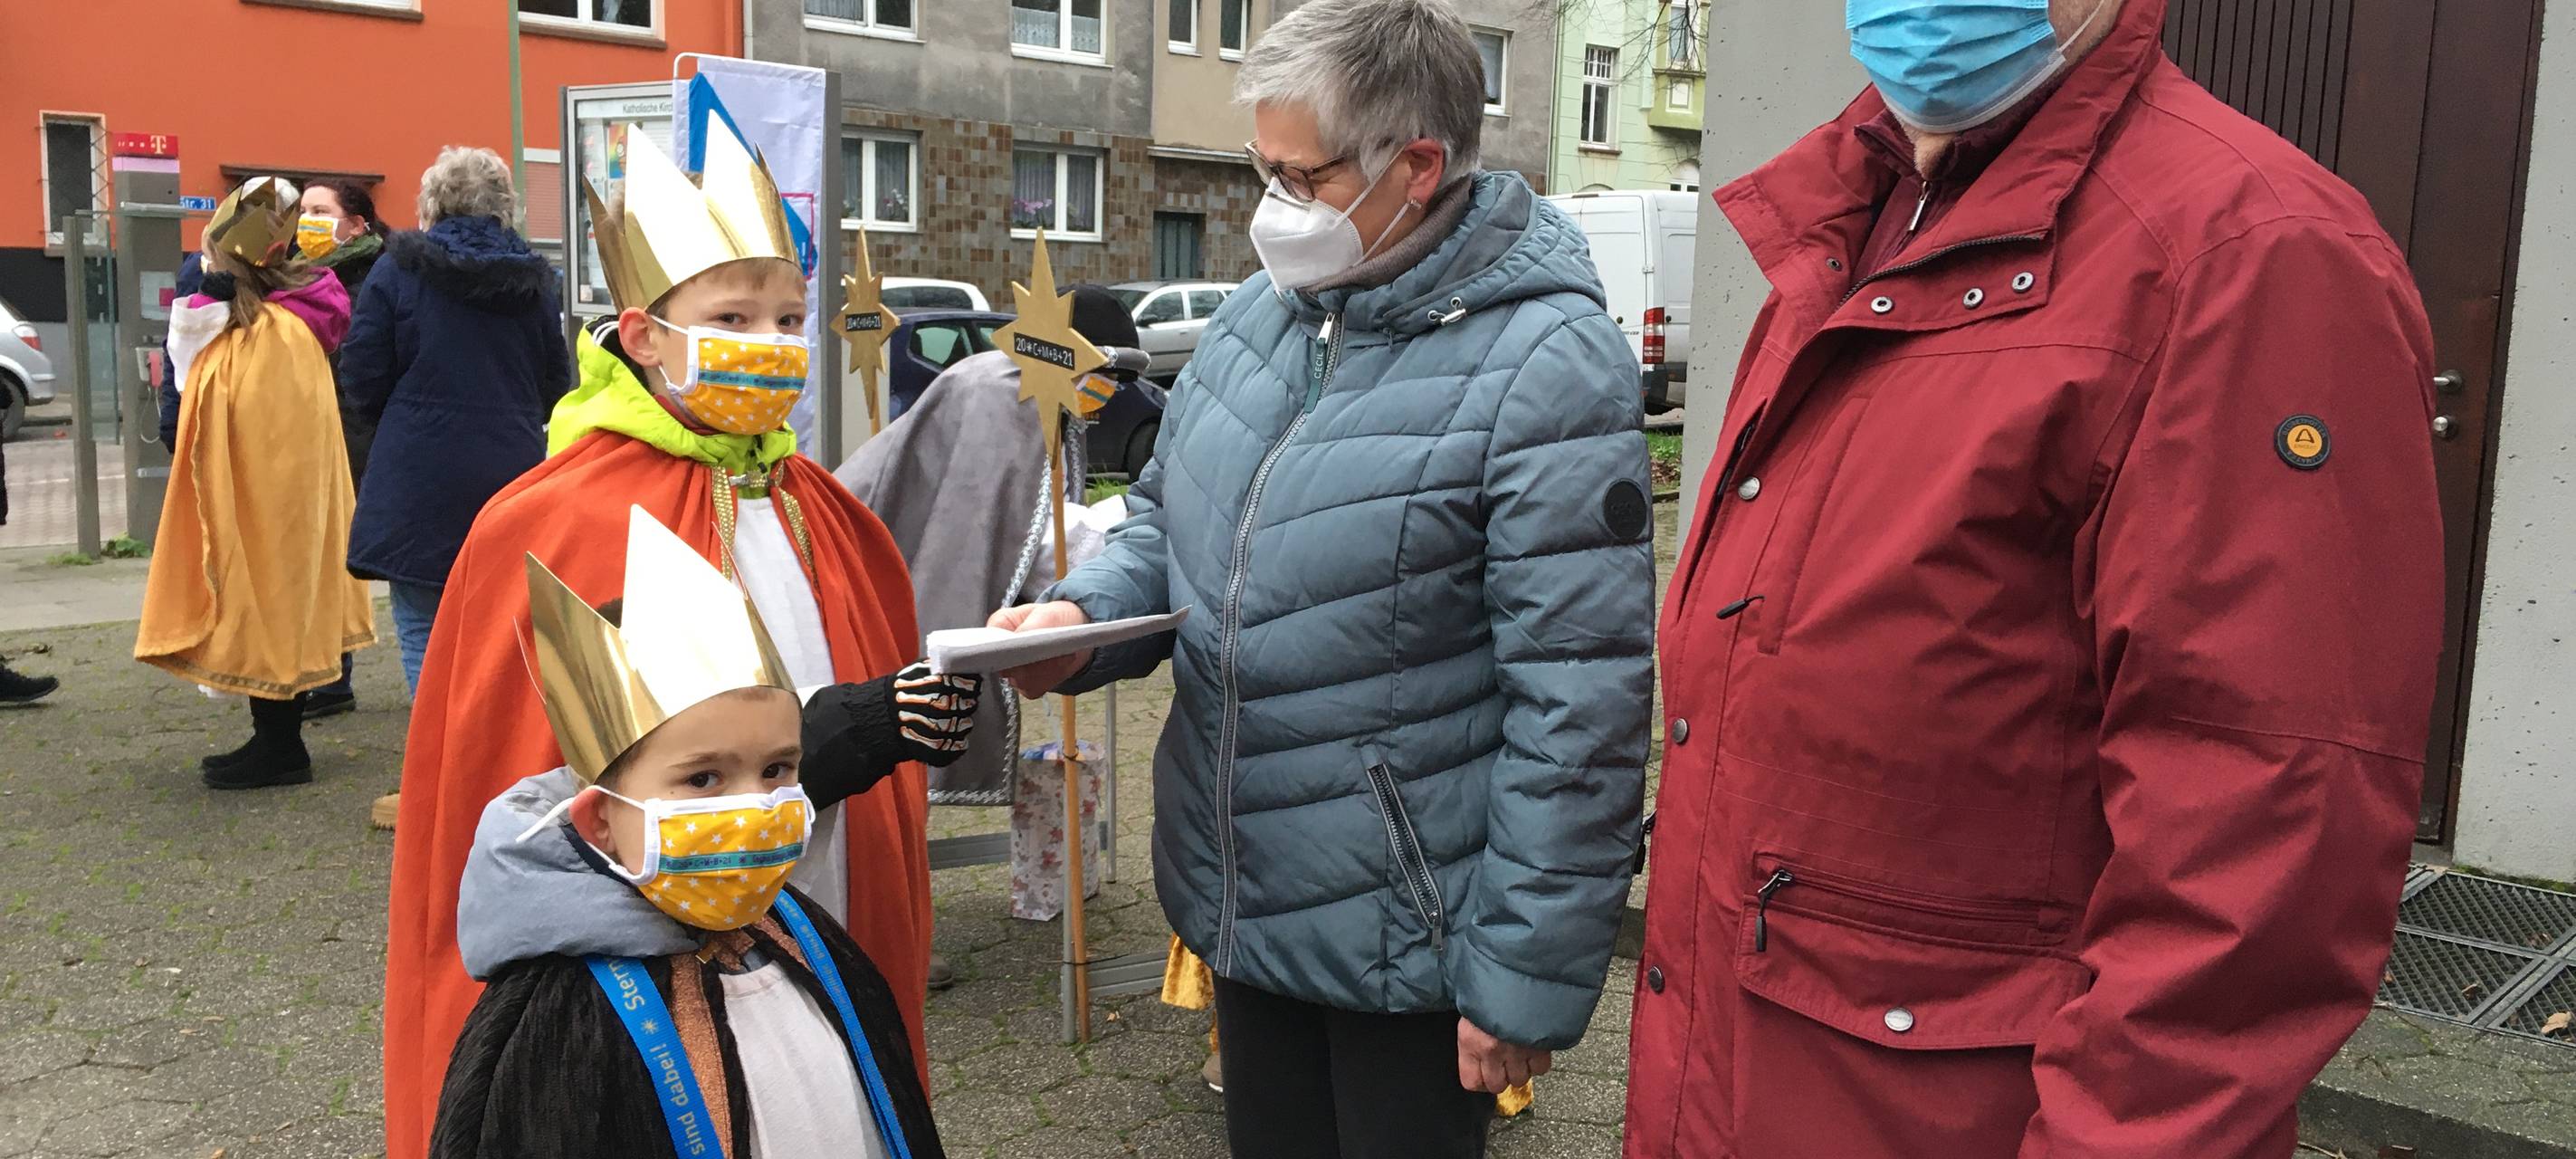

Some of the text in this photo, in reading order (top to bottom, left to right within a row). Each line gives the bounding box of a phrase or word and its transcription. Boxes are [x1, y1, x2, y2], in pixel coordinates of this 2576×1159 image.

[200, 198, 212, 209] 31
[1313, 351, 1324, 379] CECIL
[649, 1042, 690, 1106] dabei!
[677, 1110, 706, 1156] sind
